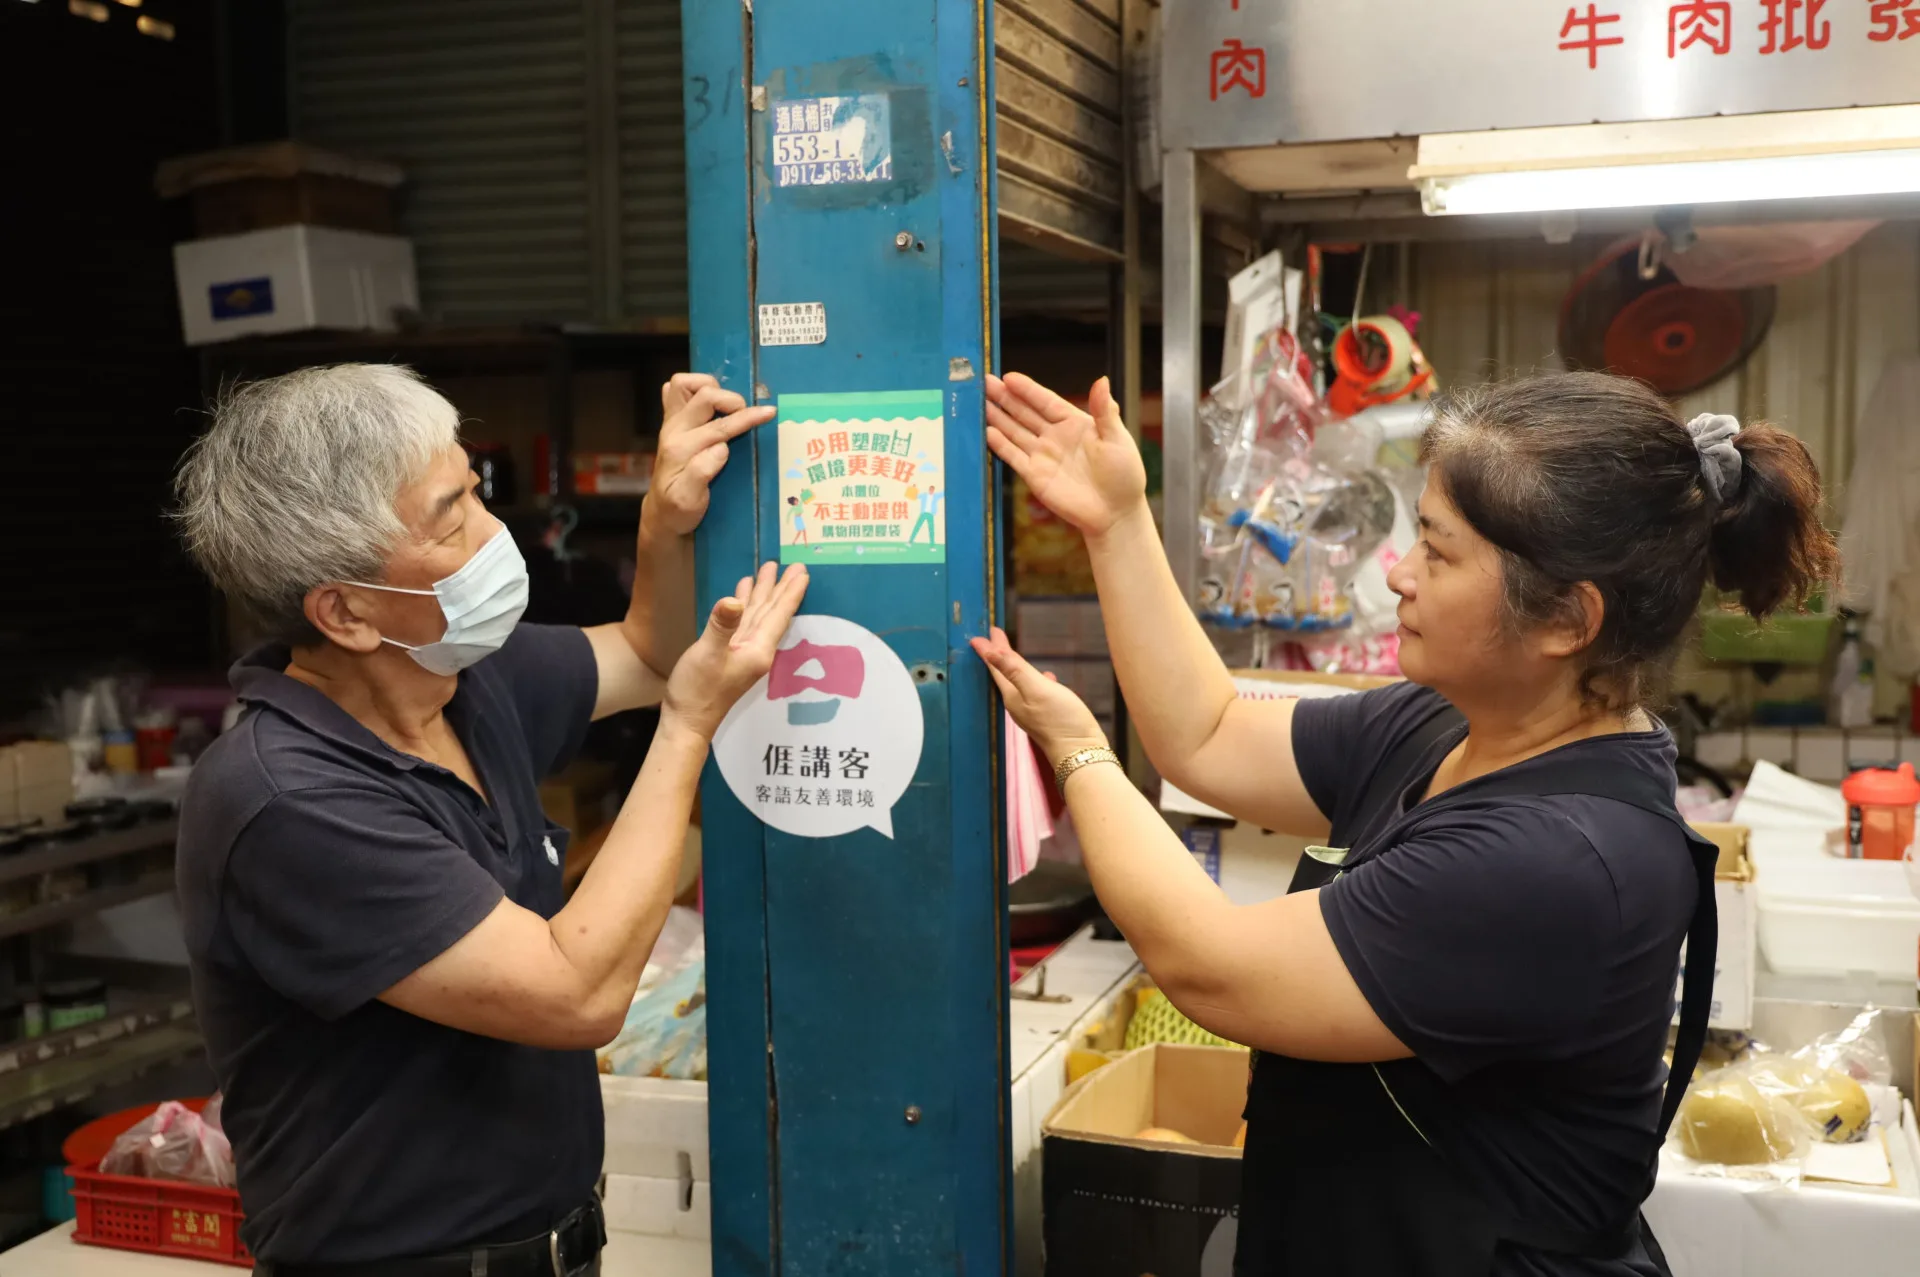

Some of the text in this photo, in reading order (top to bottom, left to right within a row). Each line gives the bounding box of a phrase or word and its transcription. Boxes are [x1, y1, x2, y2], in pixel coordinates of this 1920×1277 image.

[1209, 0, 1267, 101] 肉
[806, 454, 916, 485] 環境更美好
[813, 501, 909, 521] 不主動提供
[821, 524, 901, 538] 購物用塑膠袋
[755, 784, 875, 808] 客語友善環境
